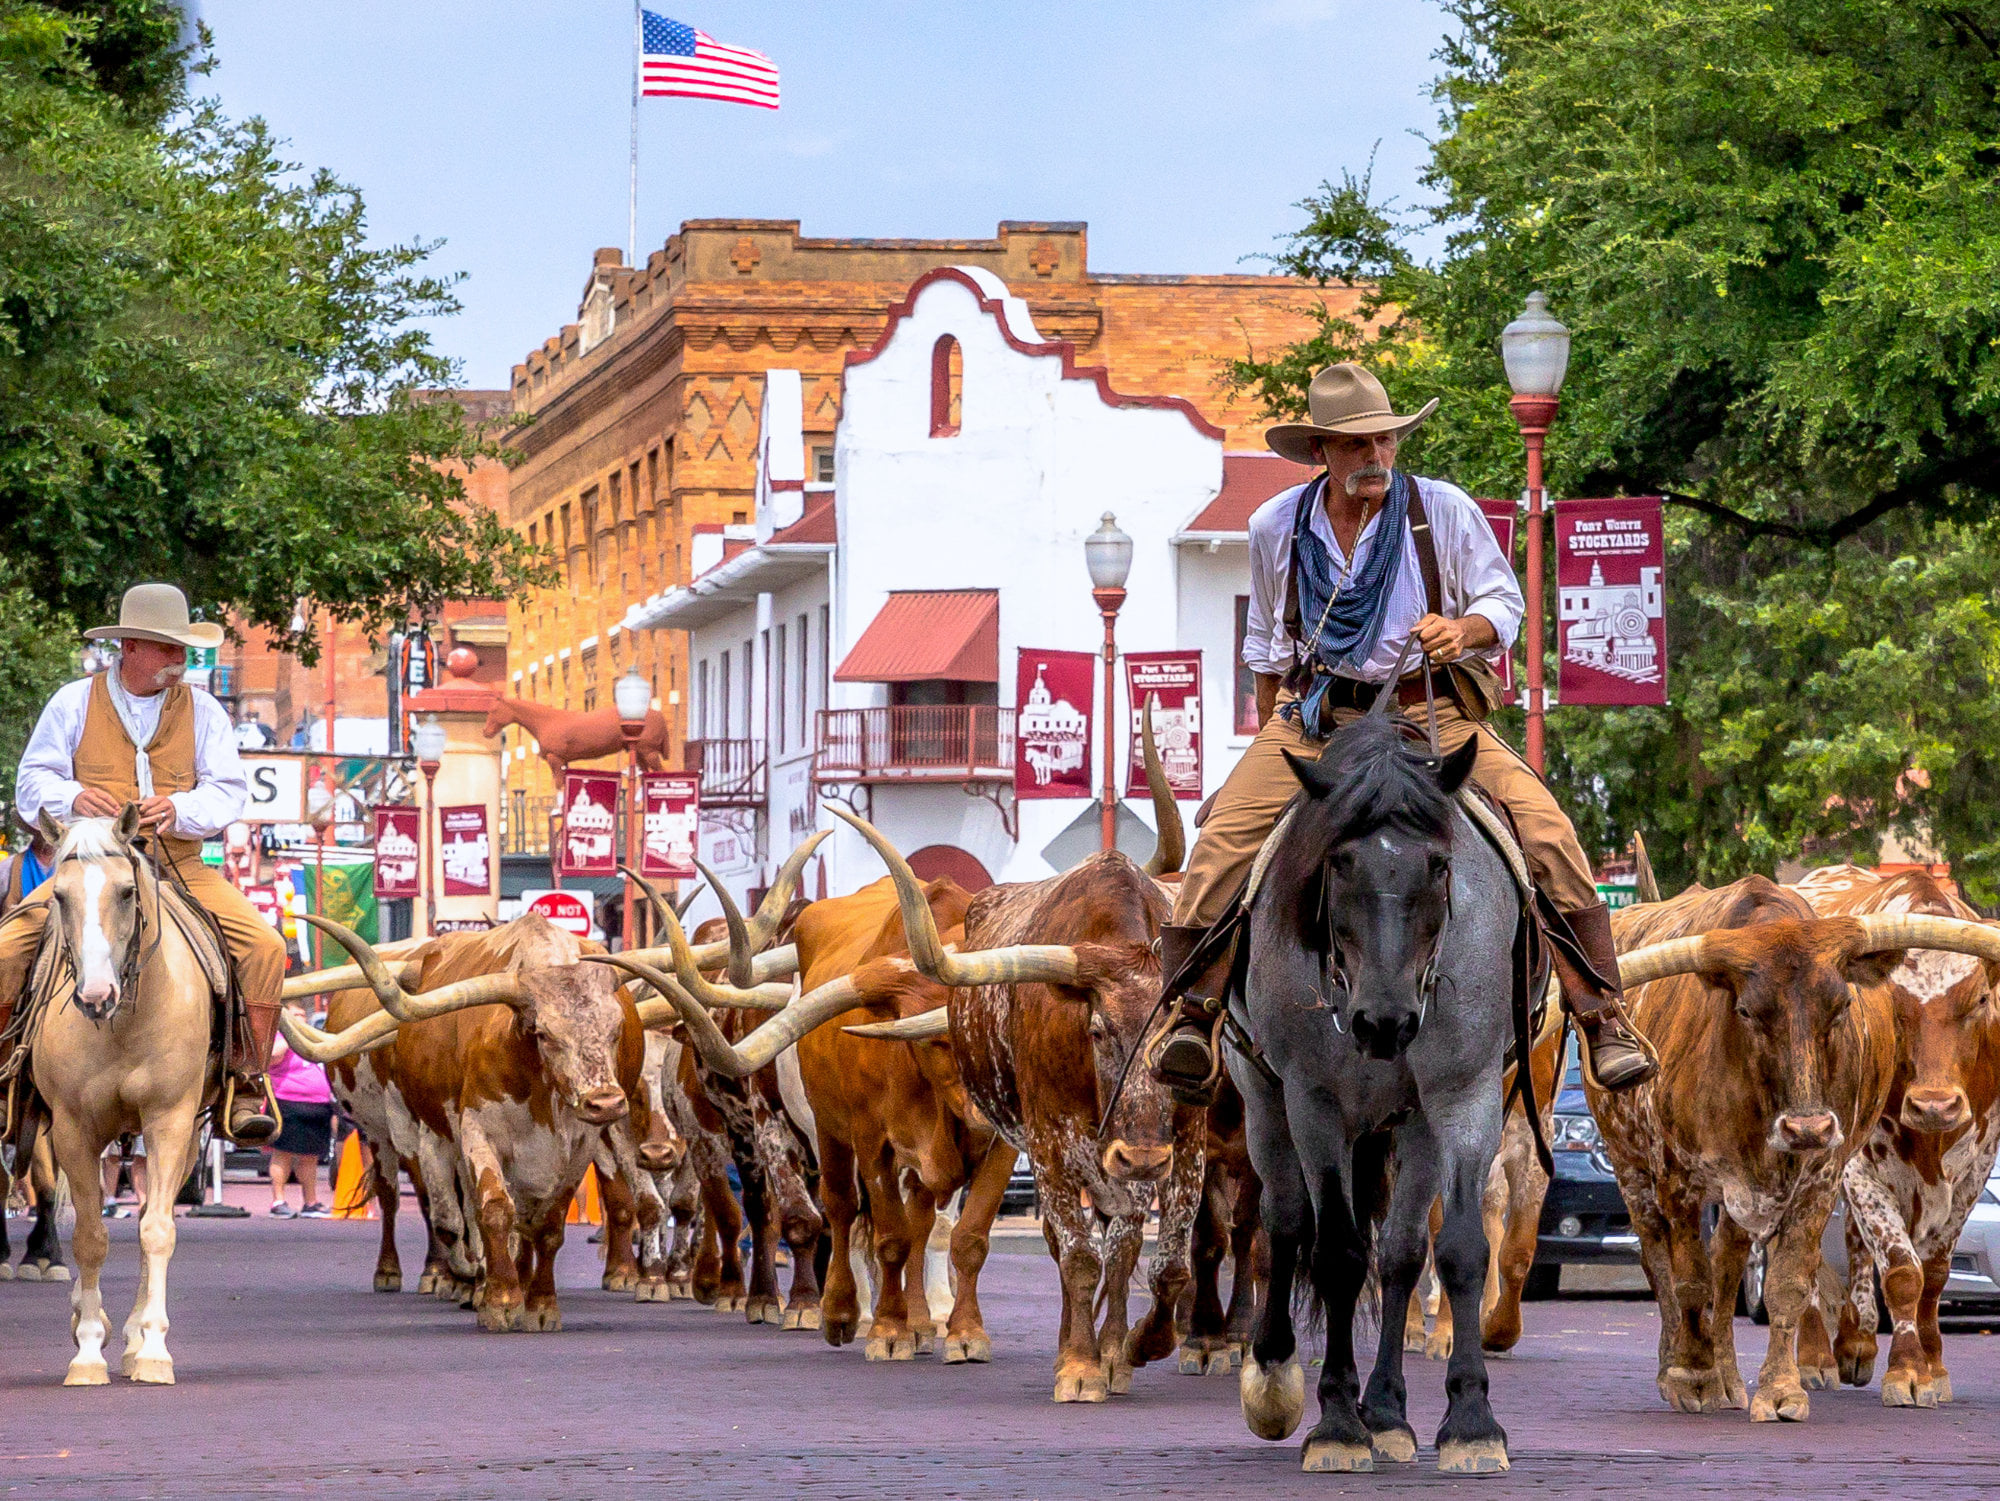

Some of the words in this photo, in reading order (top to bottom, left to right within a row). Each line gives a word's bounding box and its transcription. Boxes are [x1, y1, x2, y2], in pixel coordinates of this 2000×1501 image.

[1569, 533, 1649, 549] STOCKYARDS
[1598, 892, 1633, 905] ATM
[532, 903, 552, 917] DO
[556, 904, 582, 917] NOT
